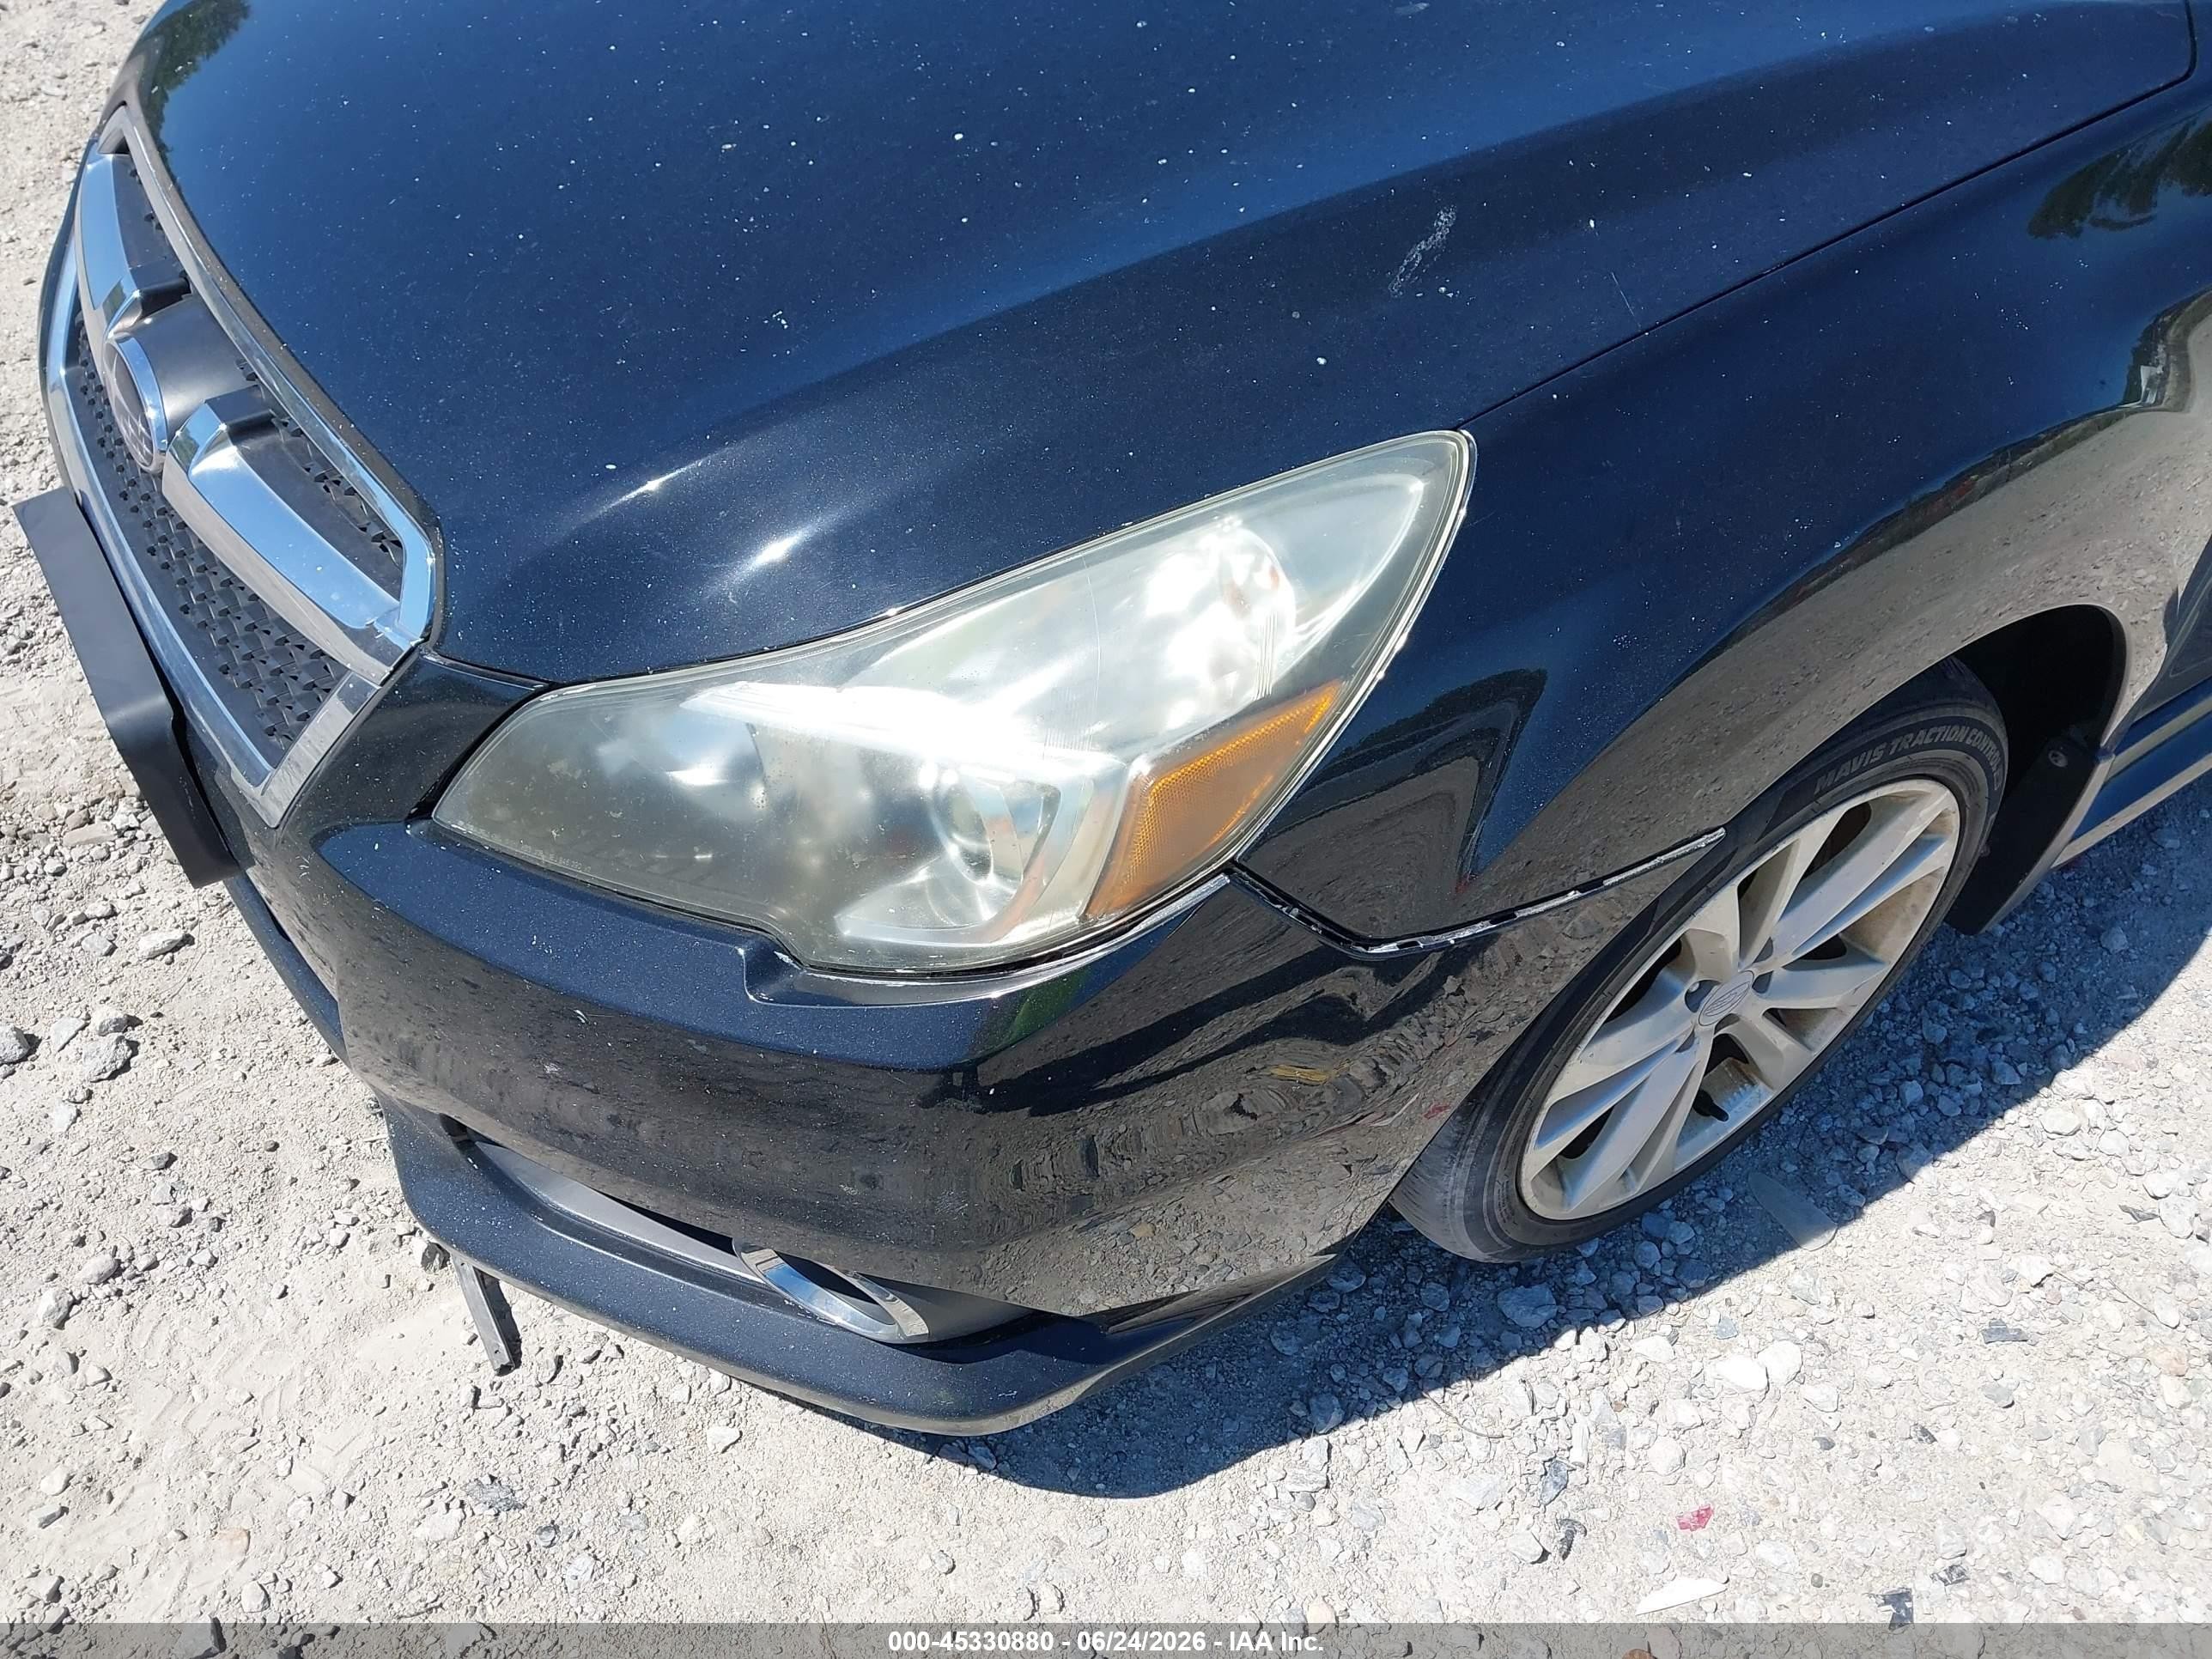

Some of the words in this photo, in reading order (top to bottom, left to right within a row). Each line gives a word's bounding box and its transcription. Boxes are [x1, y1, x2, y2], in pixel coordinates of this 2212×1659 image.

[1814, 741, 1888, 795] MAVIS
[1889, 725, 1971, 756] TRACTION
[1966, 727, 2002, 773] CONTROL
